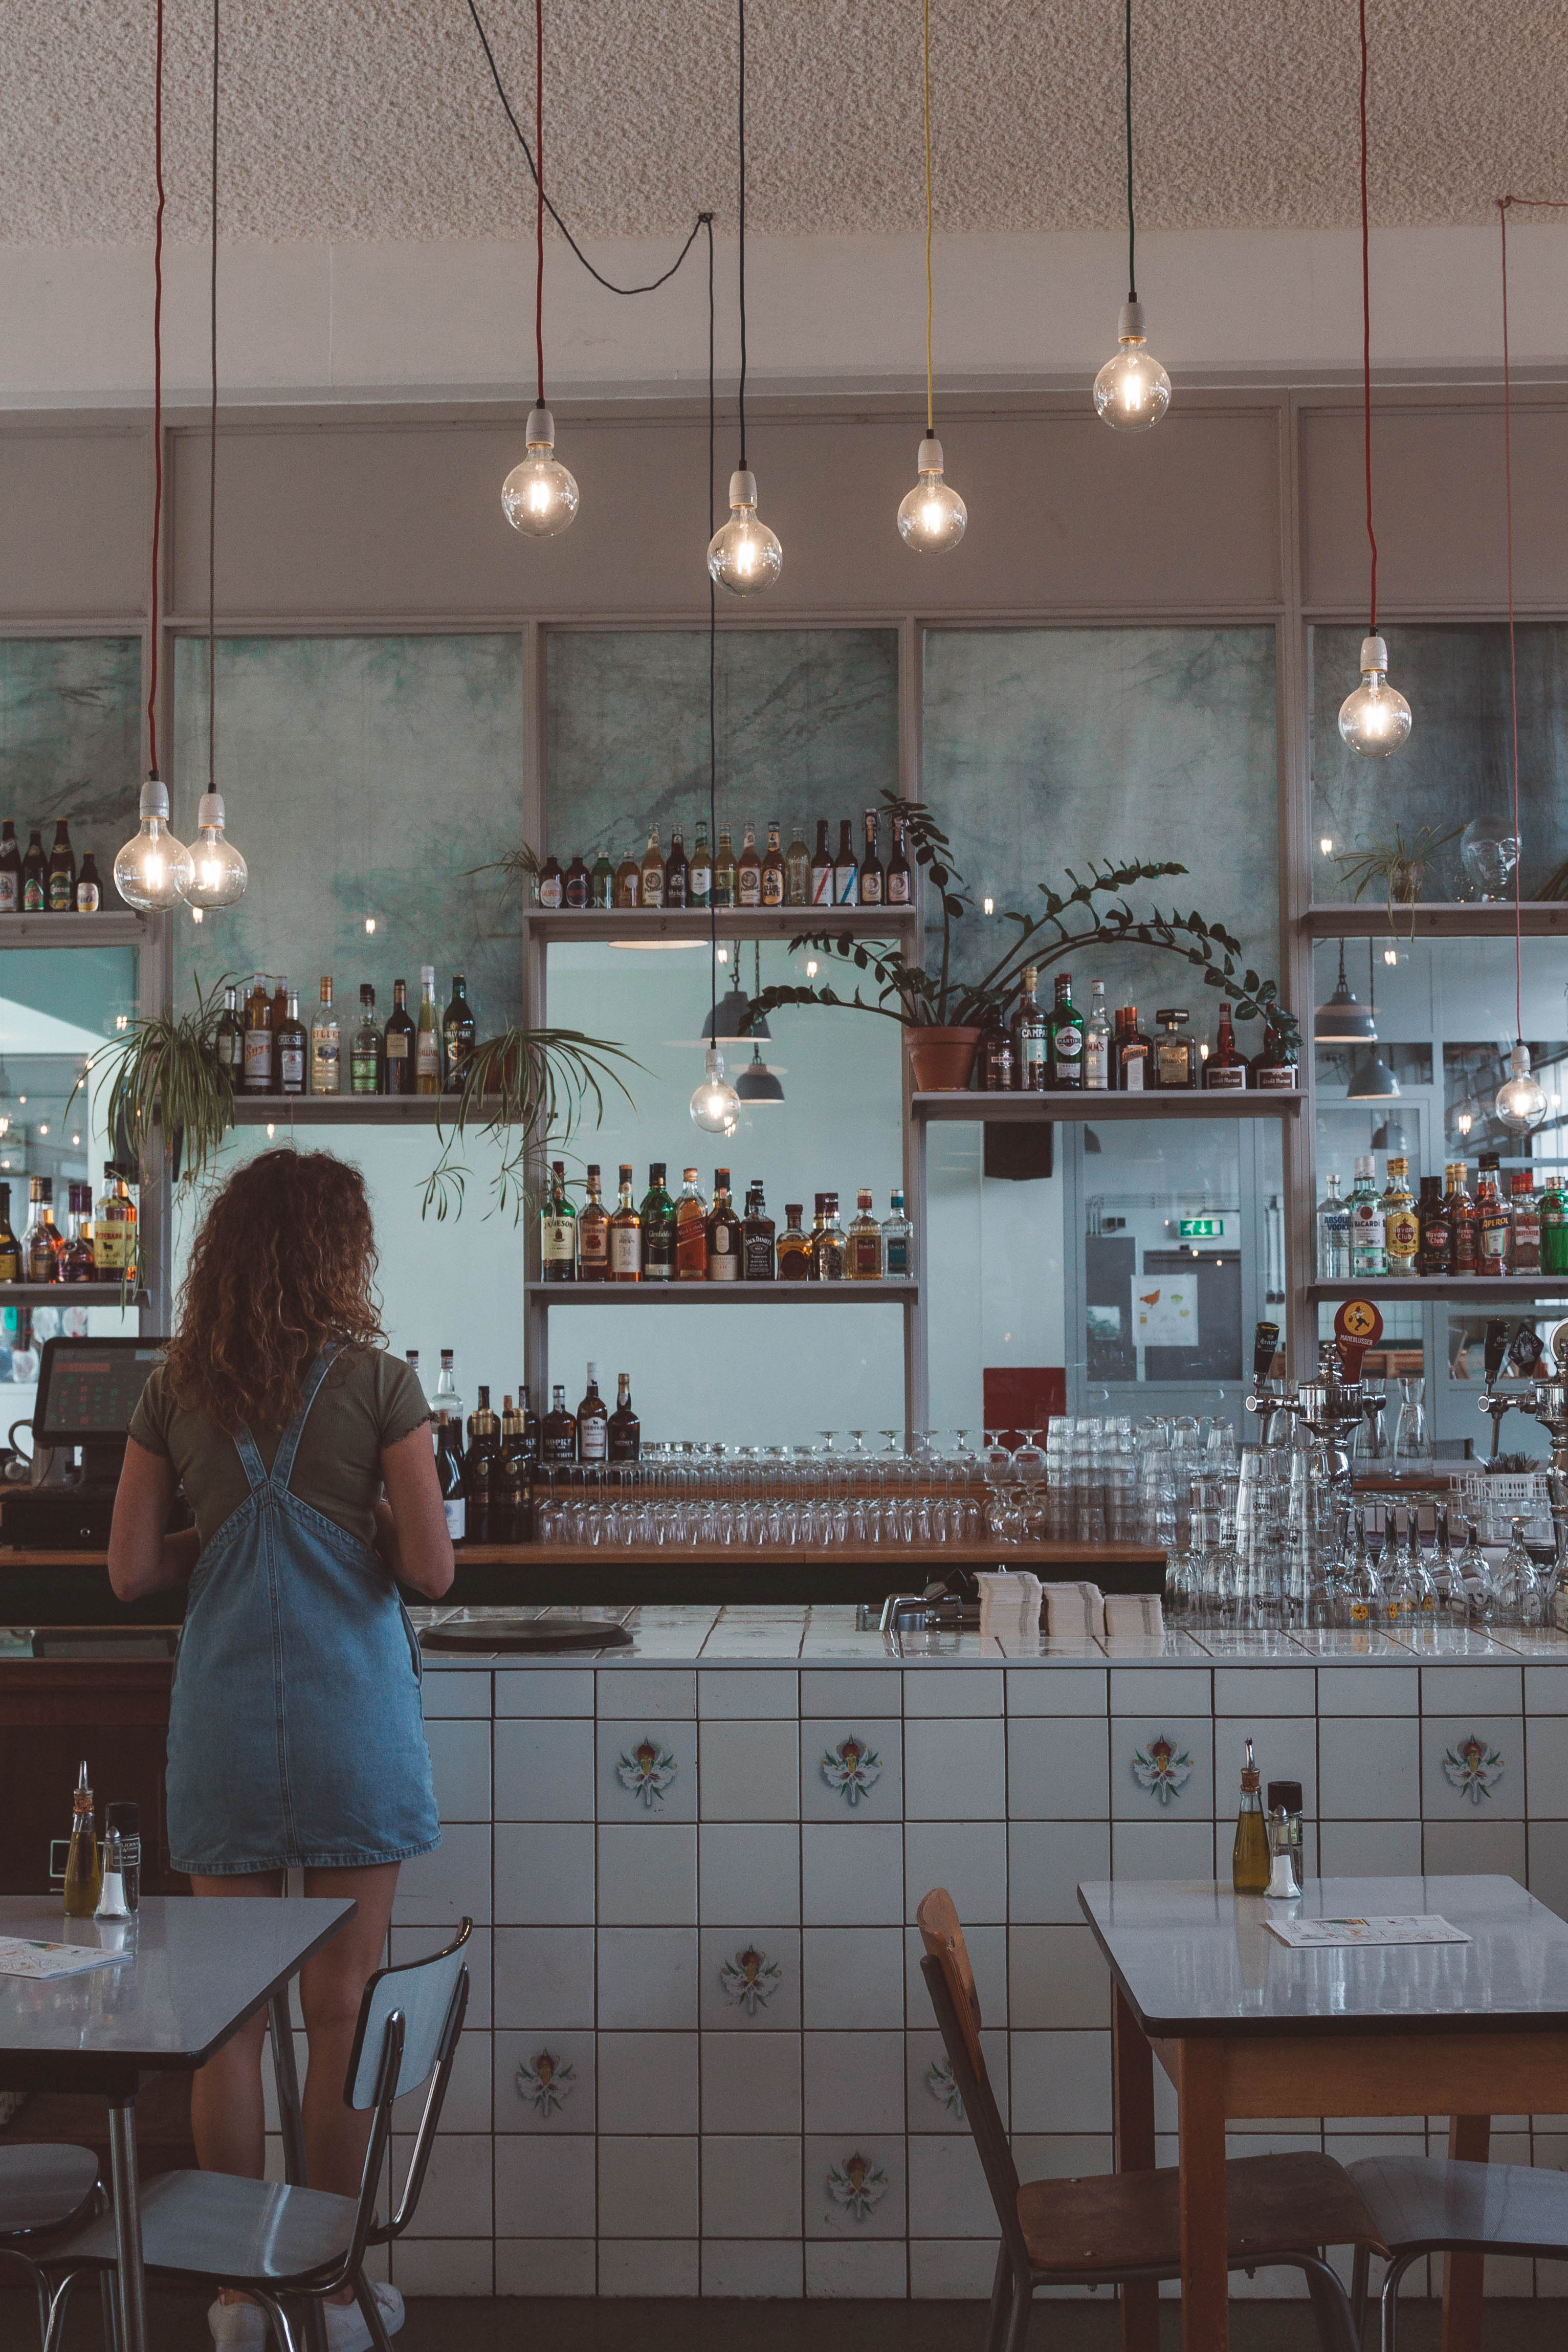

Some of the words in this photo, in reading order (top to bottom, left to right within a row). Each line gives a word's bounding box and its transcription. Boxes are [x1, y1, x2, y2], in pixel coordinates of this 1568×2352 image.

[1022, 1028, 1048, 1038] CAMPA
[1084, 1041, 1104, 1052] IMM'S
[1324, 1216, 1352, 1224] ABSOLUT
[1482, 1217, 1509, 1229] APEROL
